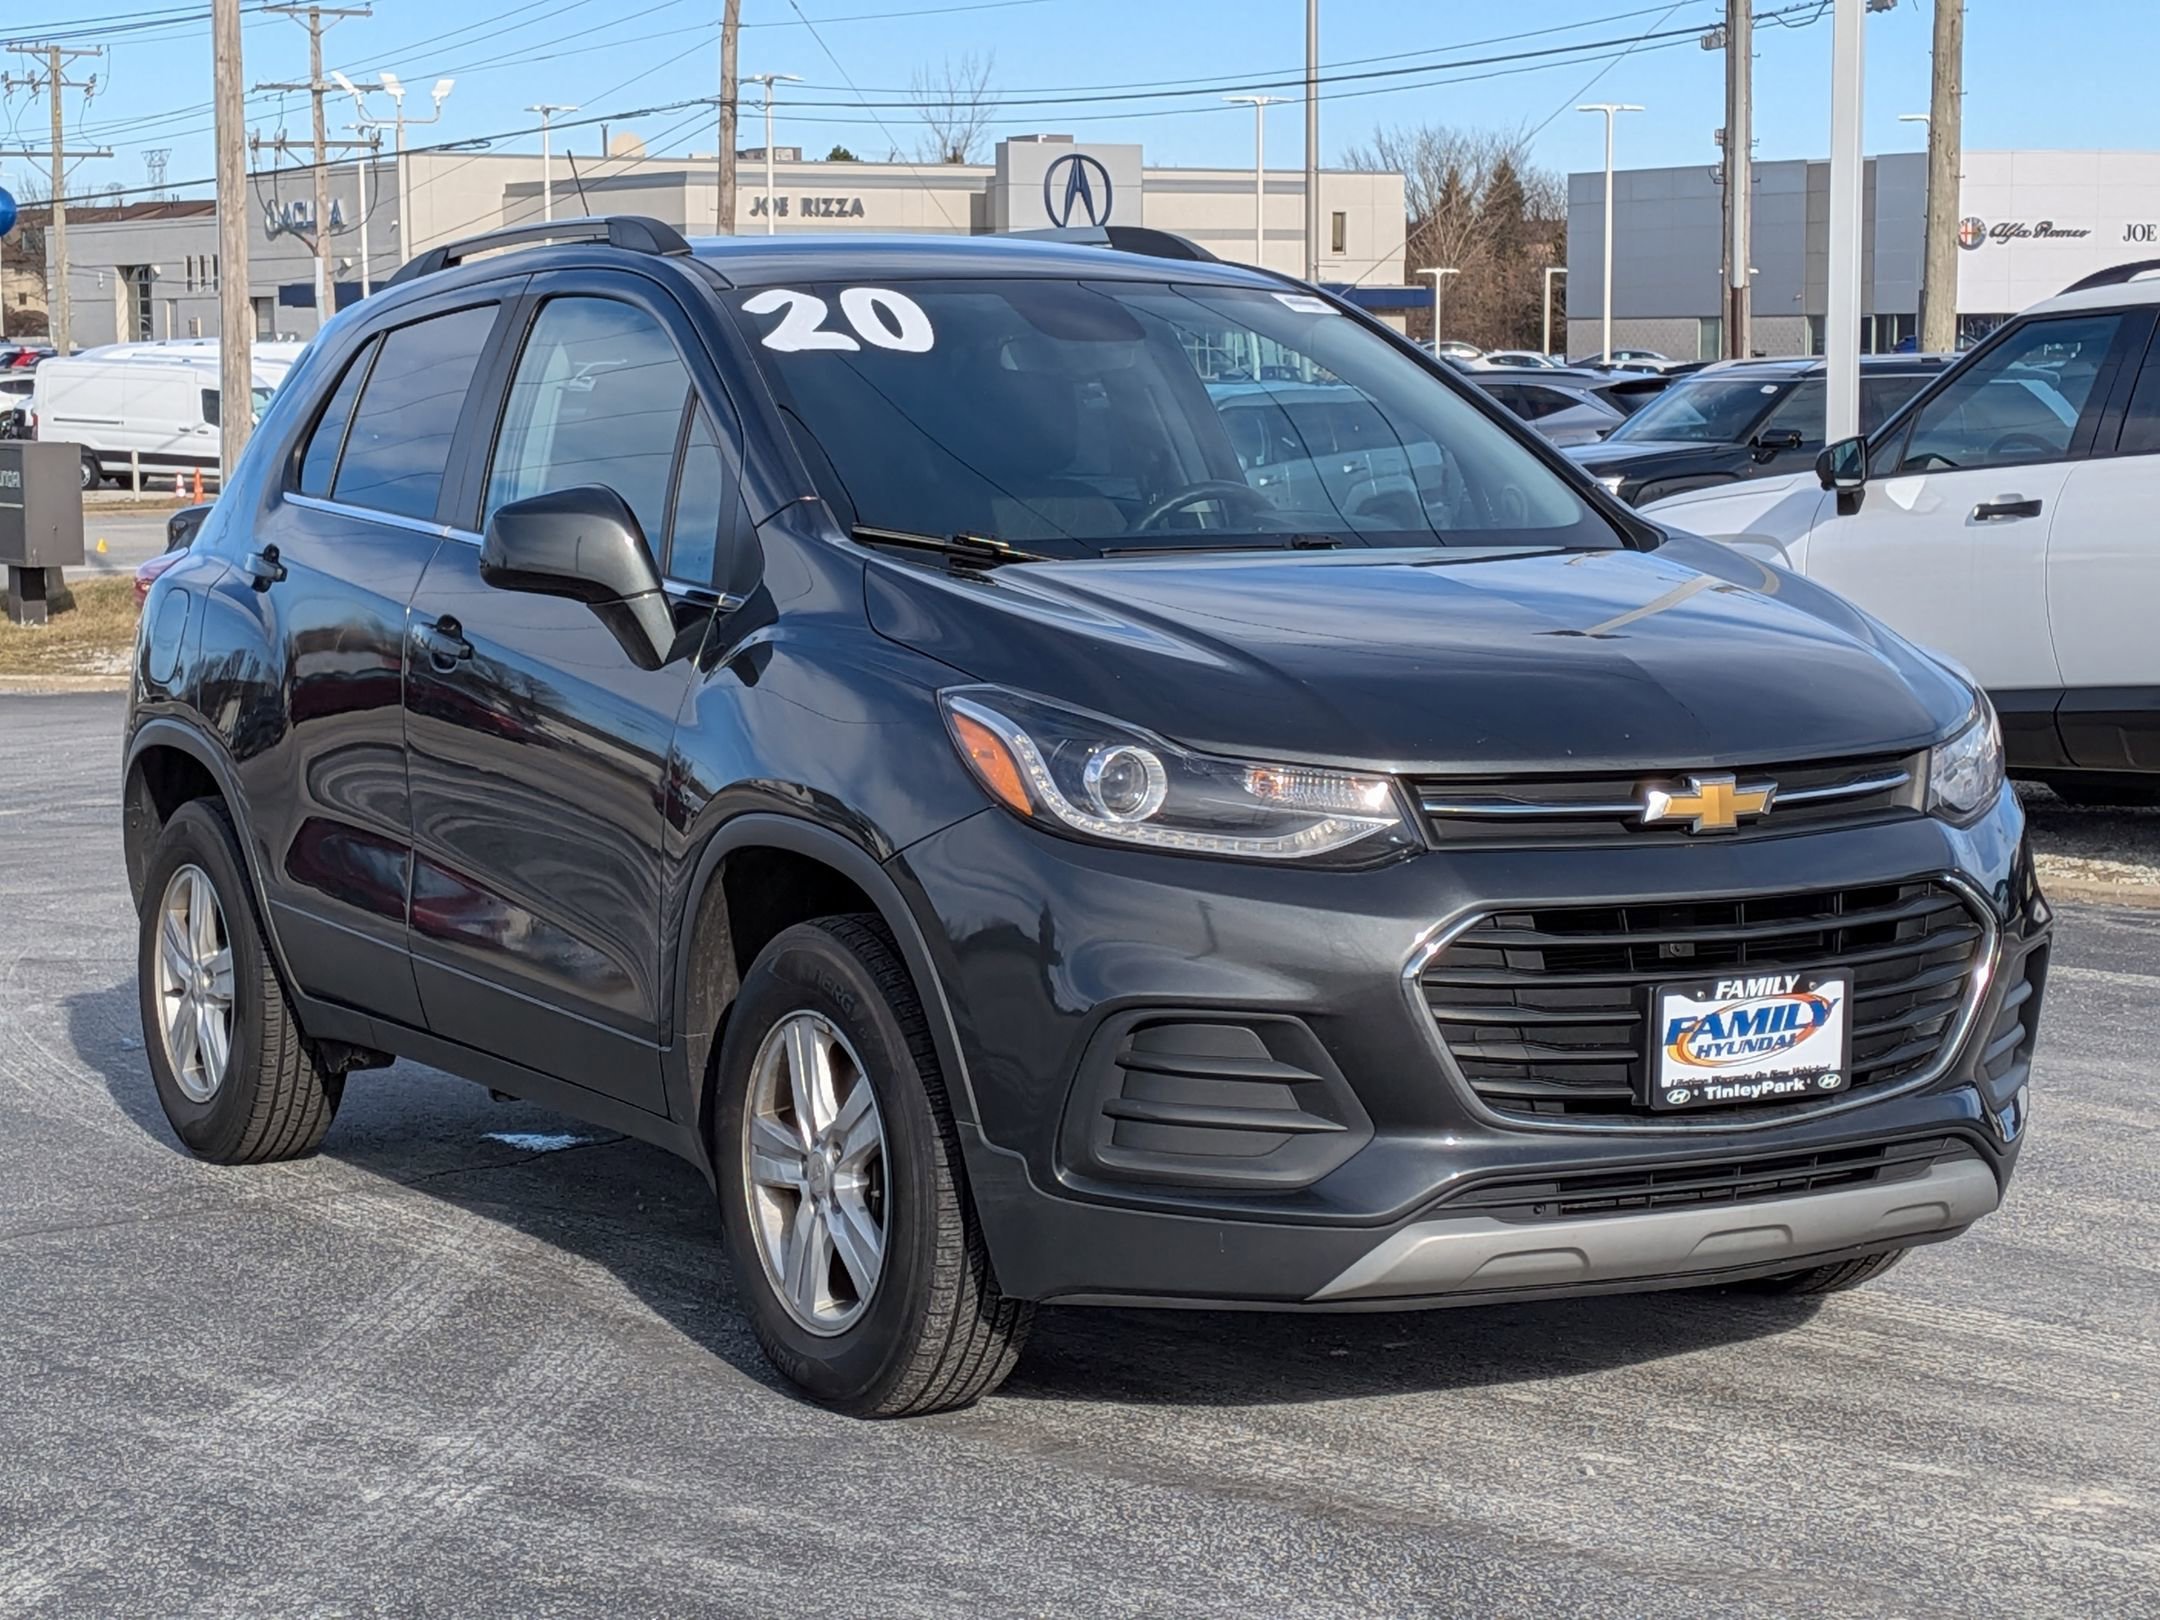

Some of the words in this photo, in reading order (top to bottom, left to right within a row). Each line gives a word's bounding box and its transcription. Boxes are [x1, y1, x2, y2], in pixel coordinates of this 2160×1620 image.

[282, 199, 344, 229] ACUA
[749, 197, 789, 217] JOE
[800, 197, 864, 218] RIZZA
[1989, 222, 2032, 244] Alfa
[2032, 221, 2091, 239] Romeo
[2122, 223, 2157, 242] JOE
[741, 287, 935, 352] 20
[1714, 974, 1801, 1000] FAMILY
[1664, 997, 1841, 1046] FAMILY
[1694, 1033, 1798, 1060] HYUNDAI
[1704, 1077, 1806, 1100] TinleyPark
